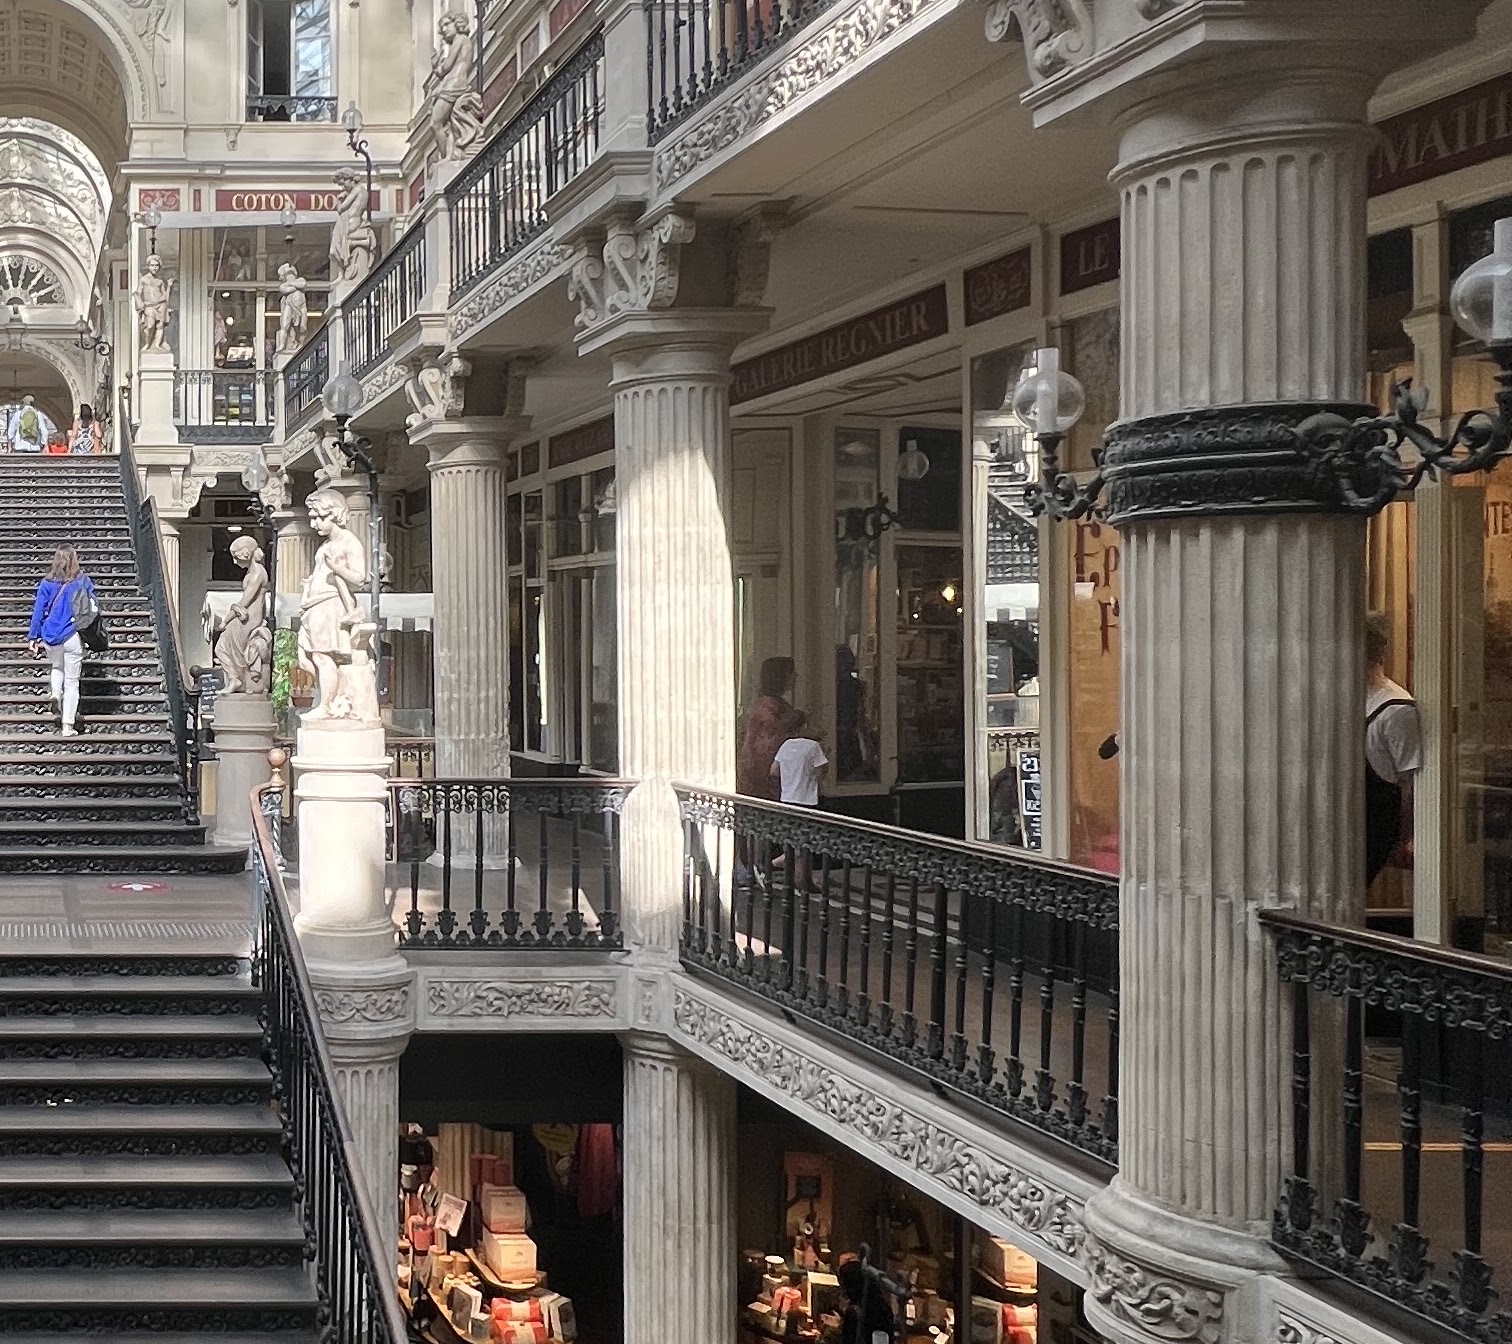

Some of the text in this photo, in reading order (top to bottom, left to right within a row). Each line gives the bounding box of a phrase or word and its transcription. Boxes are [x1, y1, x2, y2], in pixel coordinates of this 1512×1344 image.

[232, 192, 297, 212] COTON
[736, 301, 931, 397] GALERIE REGNIER
